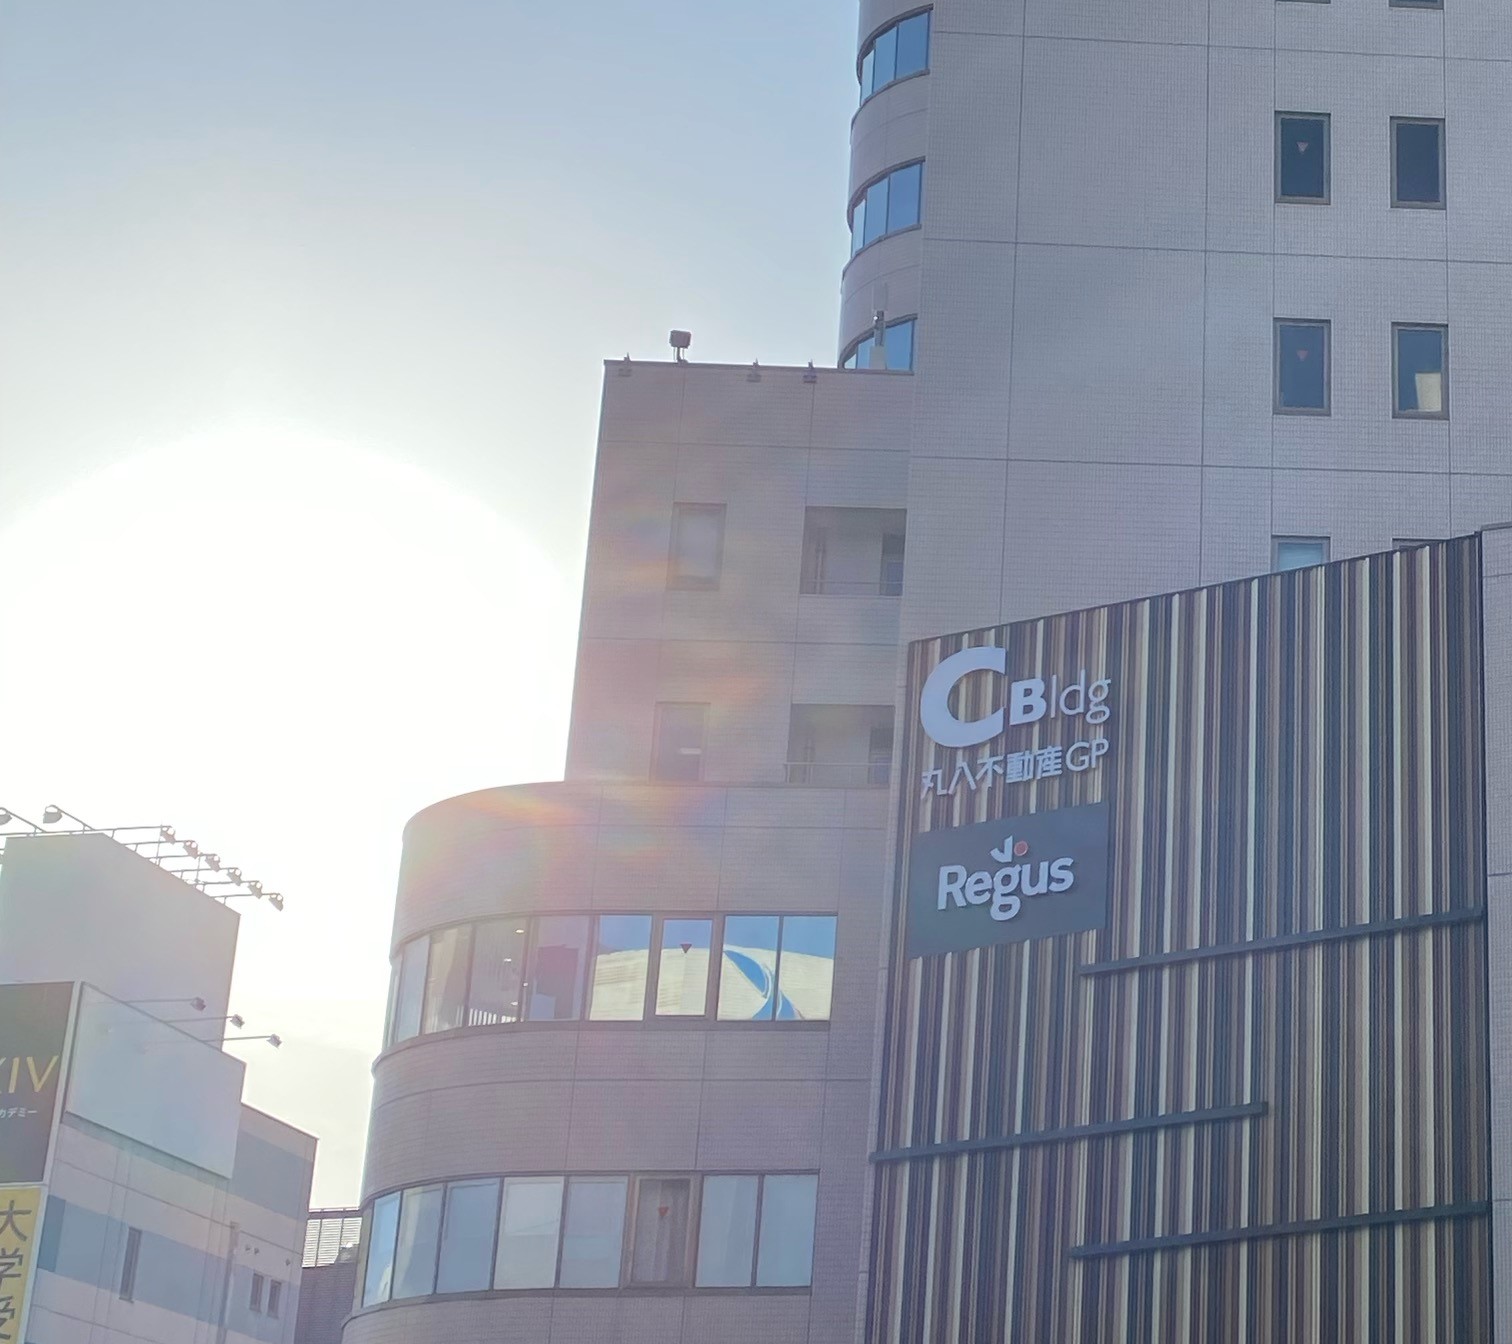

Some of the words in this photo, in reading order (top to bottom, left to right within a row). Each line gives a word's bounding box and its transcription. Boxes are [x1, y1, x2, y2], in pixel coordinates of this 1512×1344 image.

[921, 738, 1109, 799] 丸八不動産GP
[937, 856, 1074, 921] Regus
